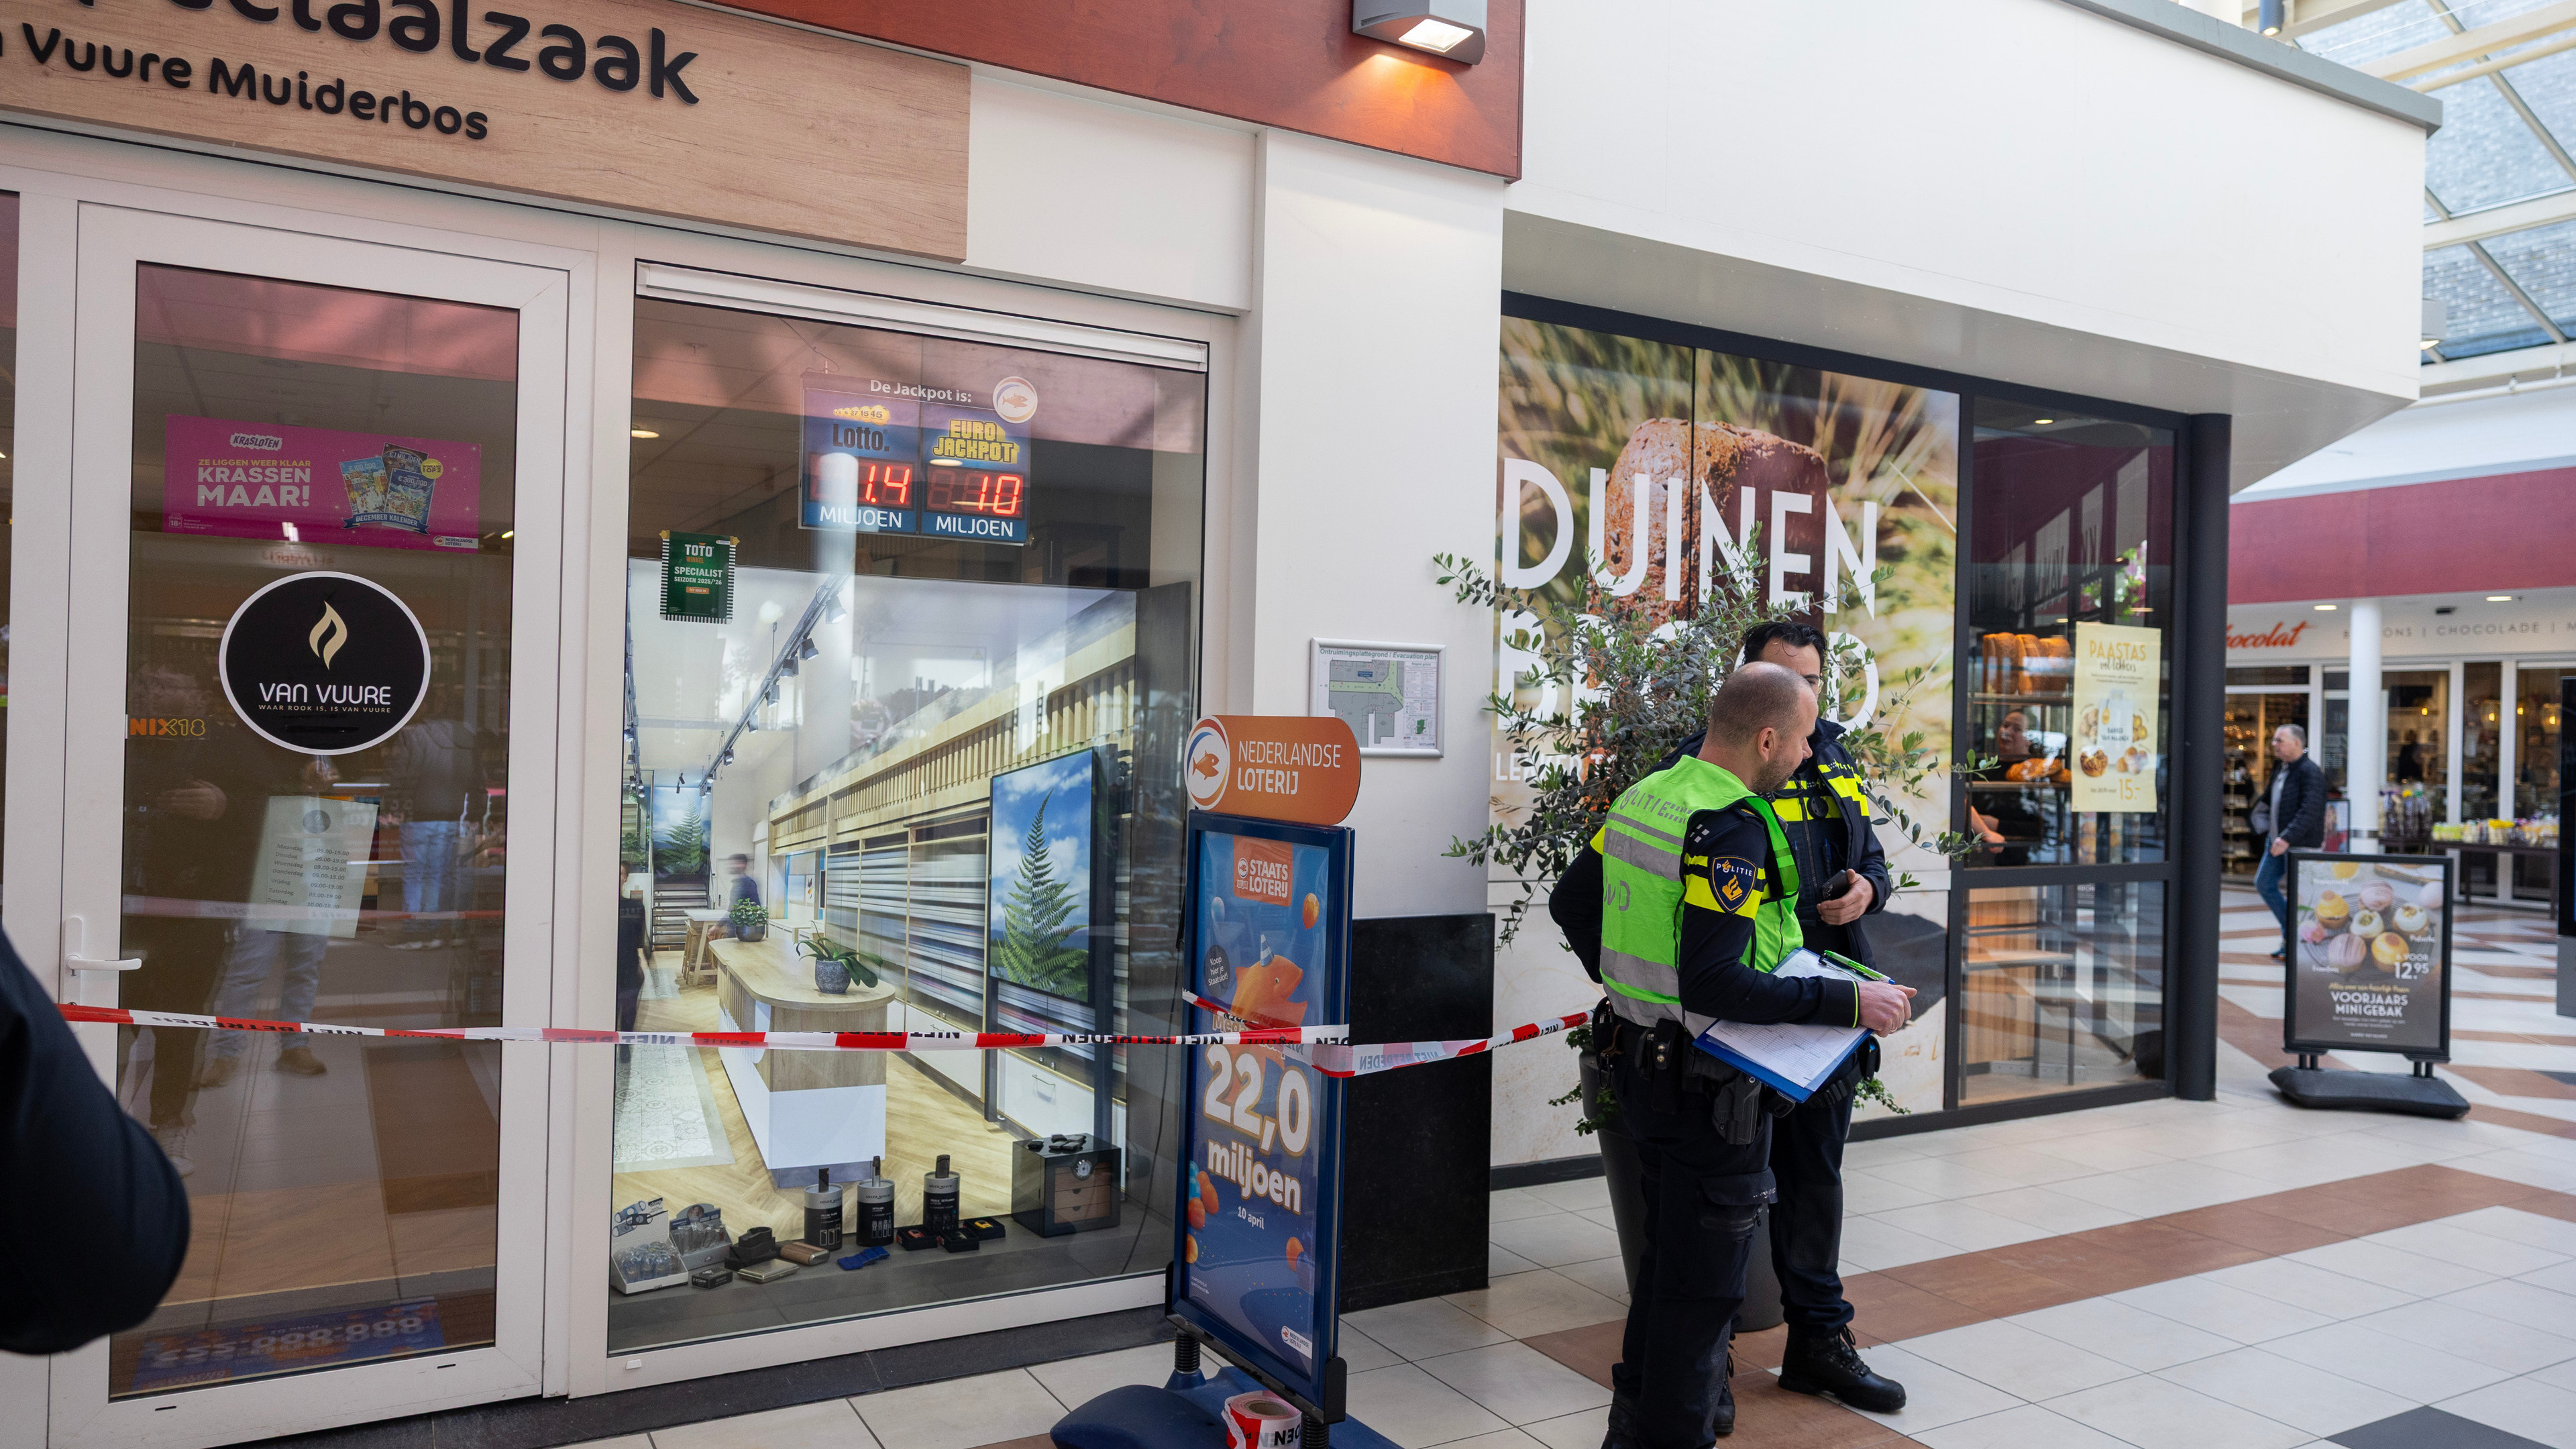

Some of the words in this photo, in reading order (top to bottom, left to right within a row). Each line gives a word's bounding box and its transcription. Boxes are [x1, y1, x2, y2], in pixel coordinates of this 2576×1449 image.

[21, 22, 193, 89] Vuure
[209, 57, 488, 140] Muiderbos
[870, 379, 891, 394] De
[894, 382, 953, 402] Jackpot
[955, 389, 972, 402] is:
[871, 410, 883, 419] 45
[949, 419, 998, 442] EURO
[233, 435, 280, 449] KRASLOTEN
[932, 436, 1016, 464] JACKPOT
[197, 467, 311, 483] KRASSEN
[865, 465, 911, 504] 1.4
[197, 484, 310, 507] MAAR!
[978, 475, 1021, 516] 10
[356, 514, 388, 523] DECEMBER
[389, 515, 418, 527] KALENDER
[820, 506, 902, 528] MILJOEN
[936, 515, 1014, 537] MILJOEN
[1501, 457, 1878, 621] DUINEN
[685, 544, 712, 557] TOTO
[674, 566, 723, 578] SPECIALIST
[2436, 621, 2540, 637] CHOCOLADE
[1320, 648, 1389, 658] Ontruimingsplattegrond
[1393, 652, 1424, 660] Evacuation
[2089, 639, 2146, 661] PAASTAS
[258, 682, 308, 704] VAN
[315, 684, 391, 706] VUURE
[1238, 740, 1342, 768] NEDERLANDSE
[1237, 767, 1299, 795] LOTERIJ
[273, 859, 304, 869] Woensdag
[275, 851, 298, 860] Dinsdag
[272, 868, 304, 877] Donderdag
[1250, 859, 1288, 881] STAATS
[270, 877, 291, 885] Vrijdag
[1249, 875, 1288, 898] LOTERIJ
[268, 887, 294, 896] Zaterdag
[266, 897, 288, 905] Zondag
[1210, 956, 1222, 966] Koop
[2404, 953, 2429, 961] VOOR
[1208, 972, 1229, 986] Staatslot!
[1210, 967, 1219, 975] hier
[2330, 991, 2409, 1006] VOORJAARS
[1204, 1044, 1311, 1159] 22,0
[1208, 1139, 1301, 1215] miljoen
[1237, 1205, 1246, 1220] 10
[1248, 1213, 1265, 1230] april
[1289, 1331, 1309, 1349] NEDERLANDSE
